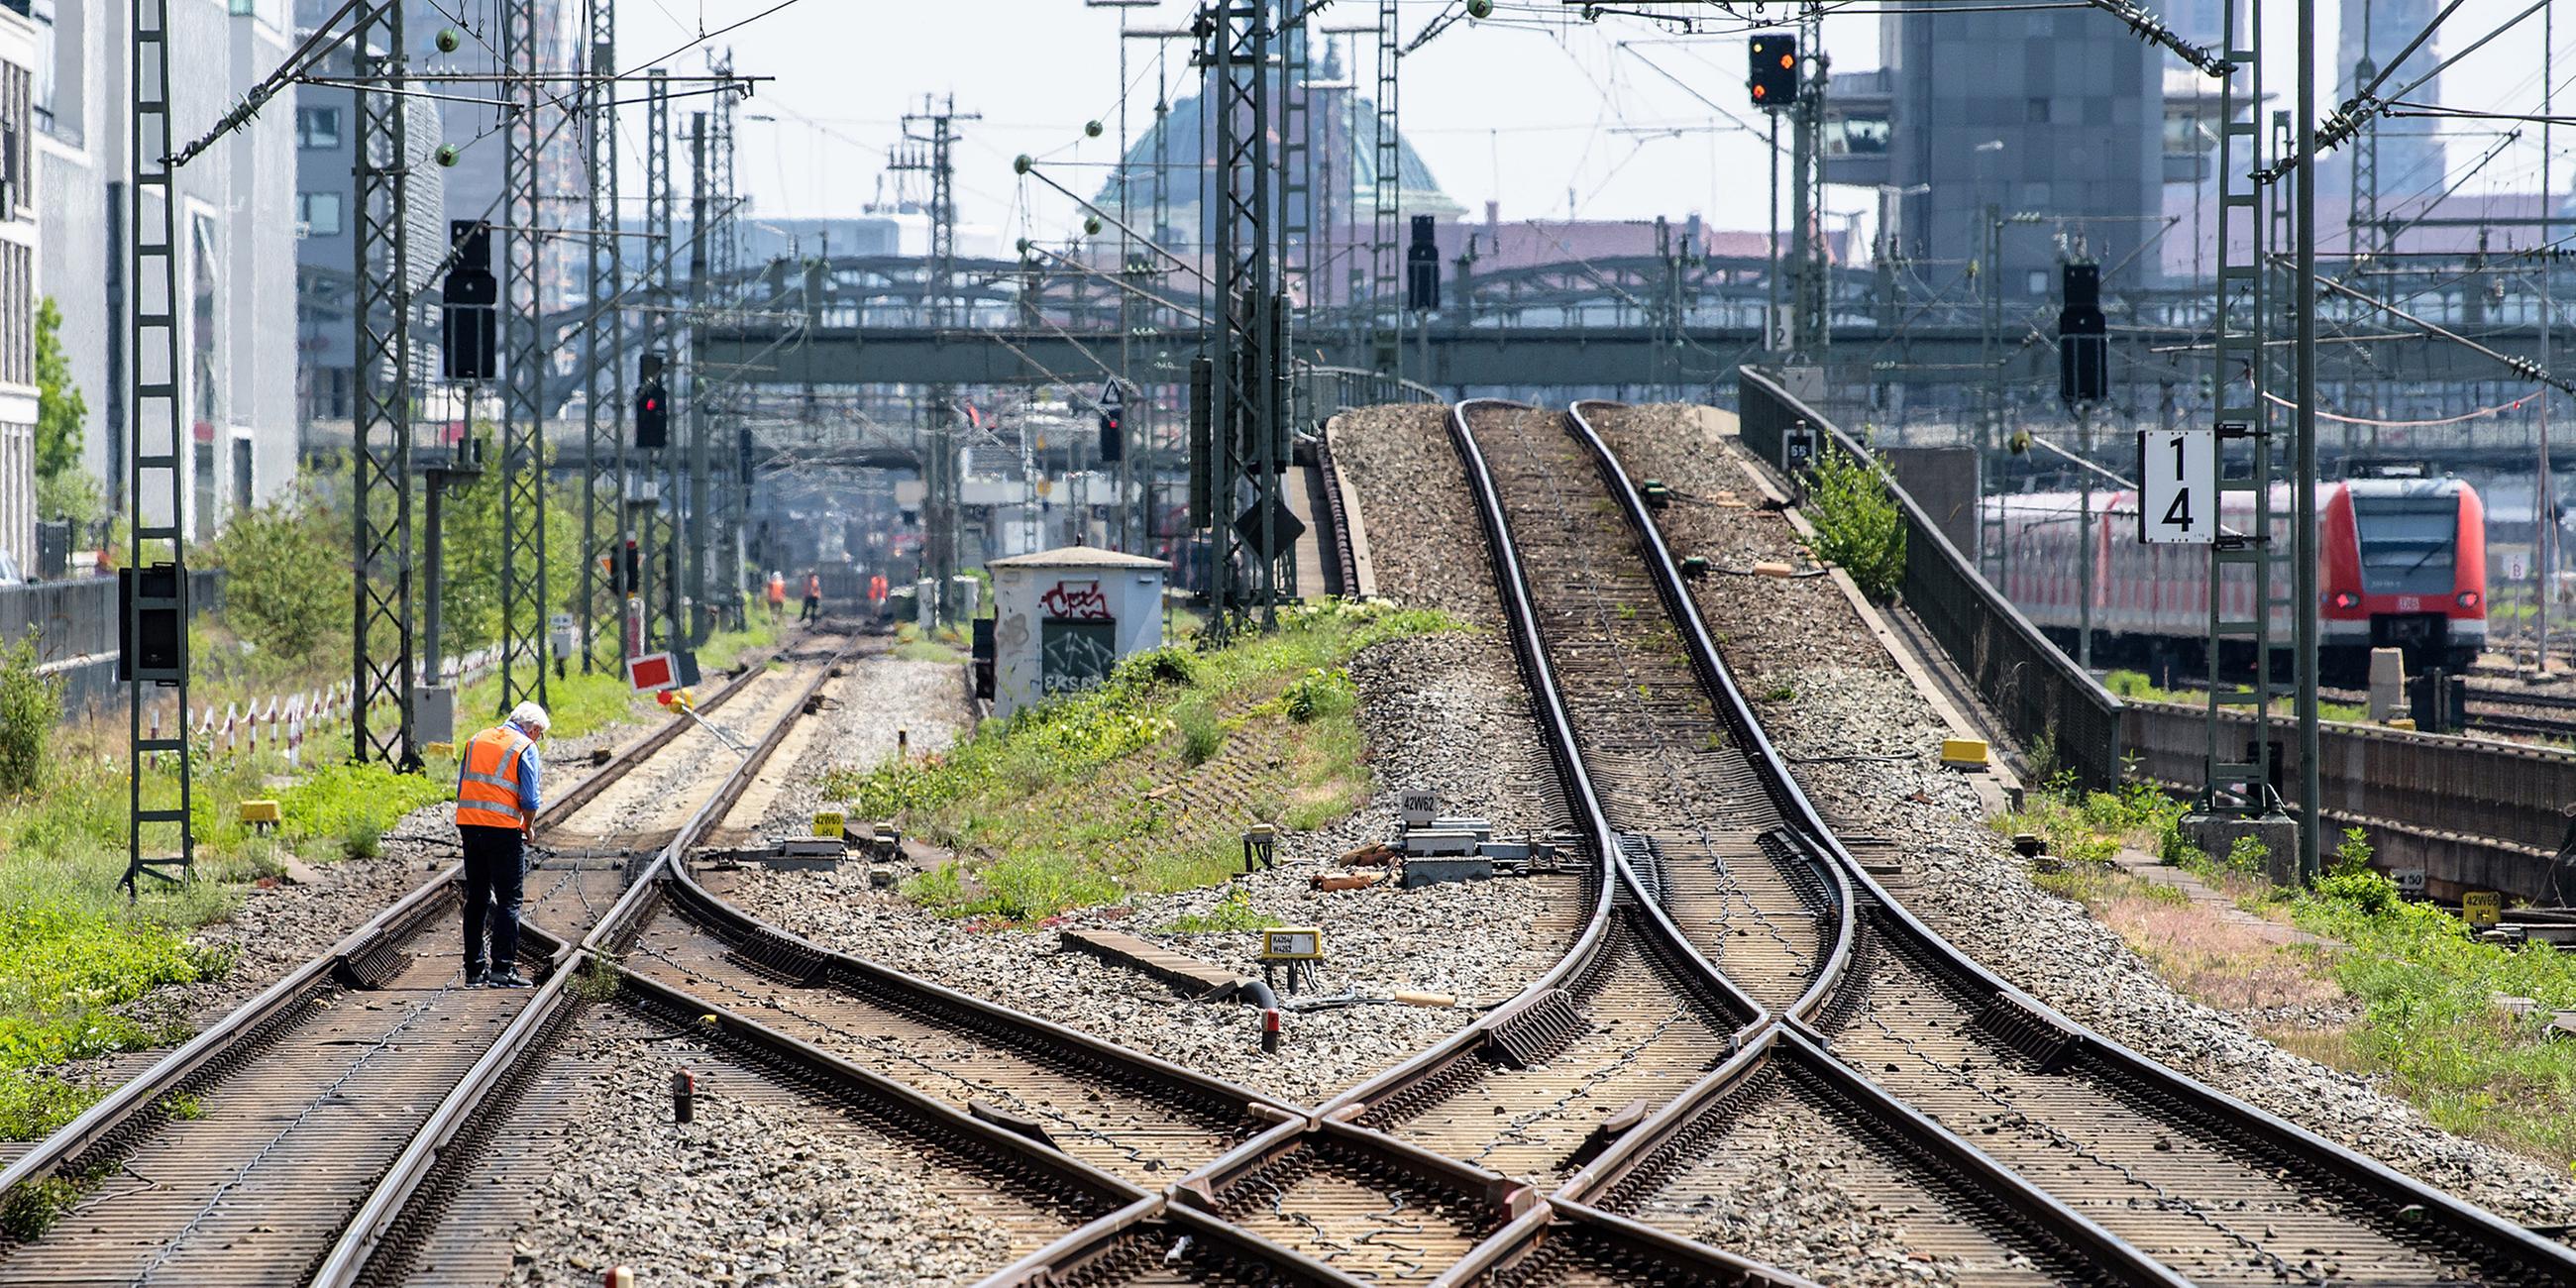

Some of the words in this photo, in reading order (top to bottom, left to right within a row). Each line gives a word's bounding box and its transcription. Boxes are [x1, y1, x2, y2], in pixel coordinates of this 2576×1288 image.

[2170, 436, 2184, 482] 1
[2161, 487, 2194, 532] 4
[1404, 796, 1435, 811] 42W62
